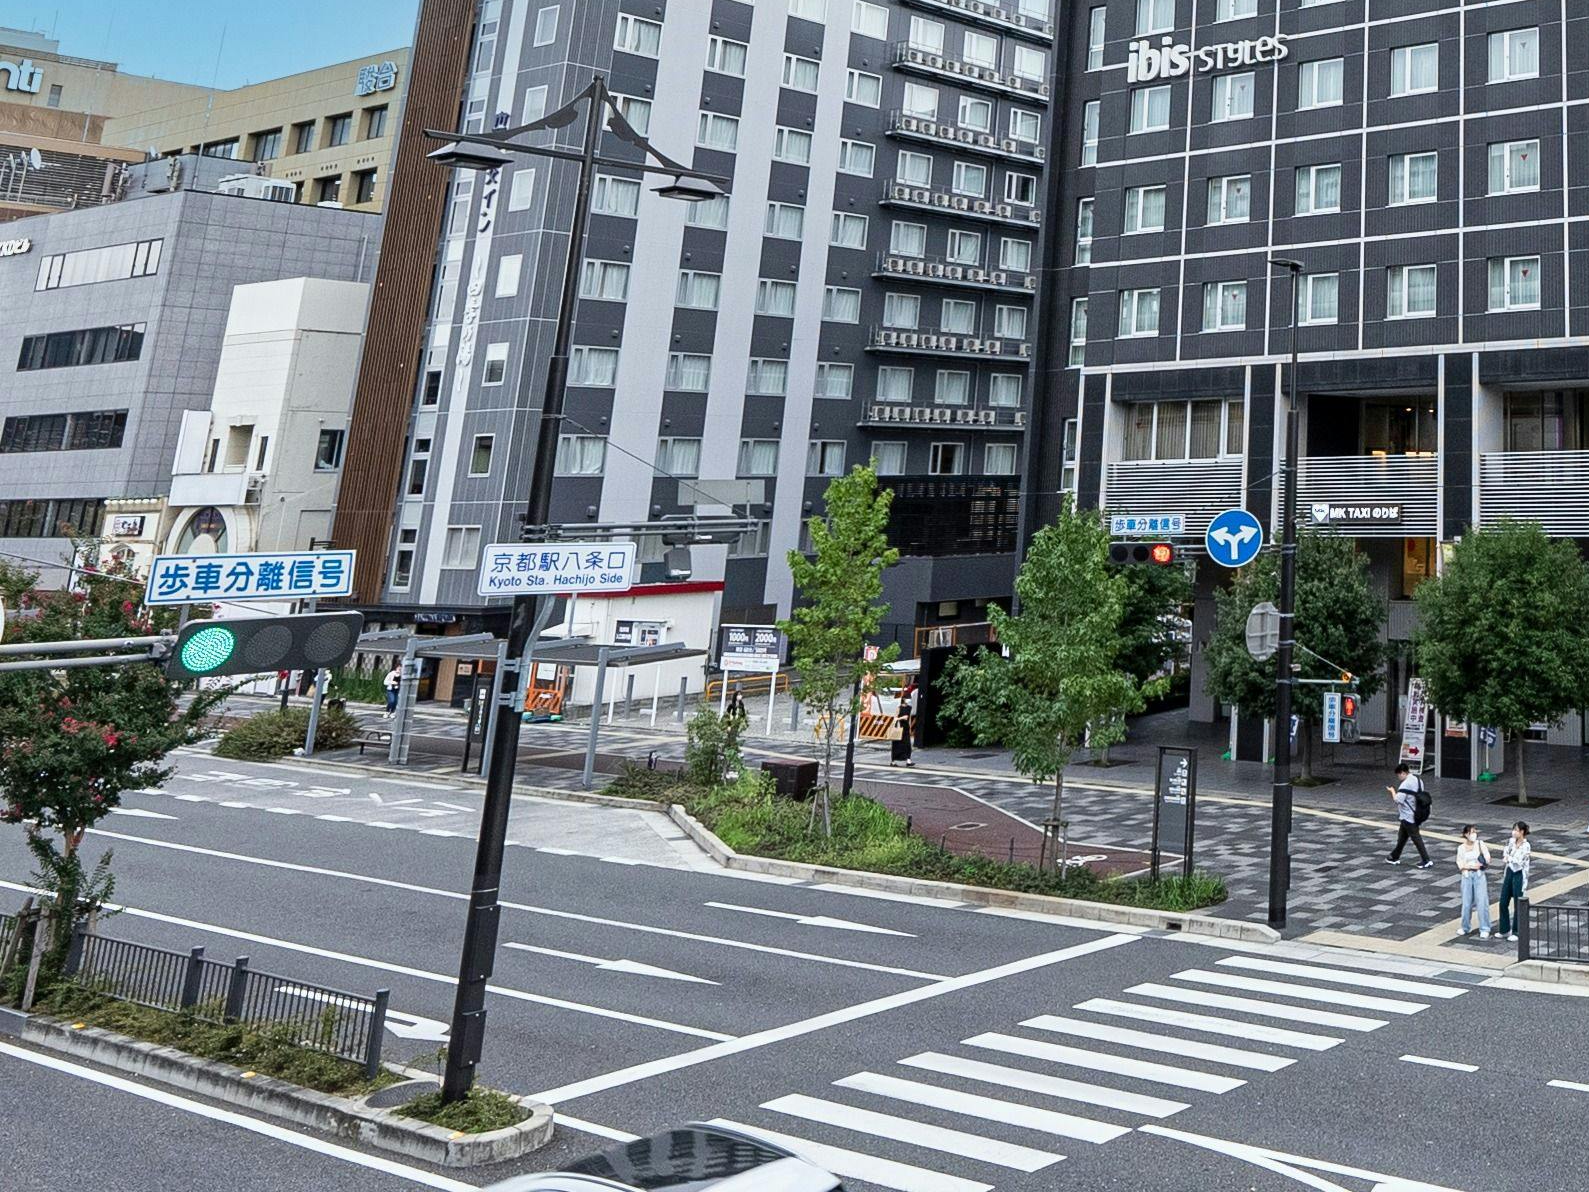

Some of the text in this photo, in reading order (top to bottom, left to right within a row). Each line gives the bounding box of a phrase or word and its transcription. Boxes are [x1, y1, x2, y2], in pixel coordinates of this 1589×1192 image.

[1127, 36, 1190, 83] ibis
[354, 61, 398, 96] 駿台
[1330, 507, 1346, 518] MK
[1348, 507, 1370, 519] TAXI
[1372, 507, 1398, 518] のりば
[1115, 518, 1181, 531] 歩車分離信号
[491, 551, 625, 573] 京都駅八条口
[158, 559, 344, 595] 歩車分離信号
[489, 572, 623, 589] Kyoto Sta. Hachijo Side
